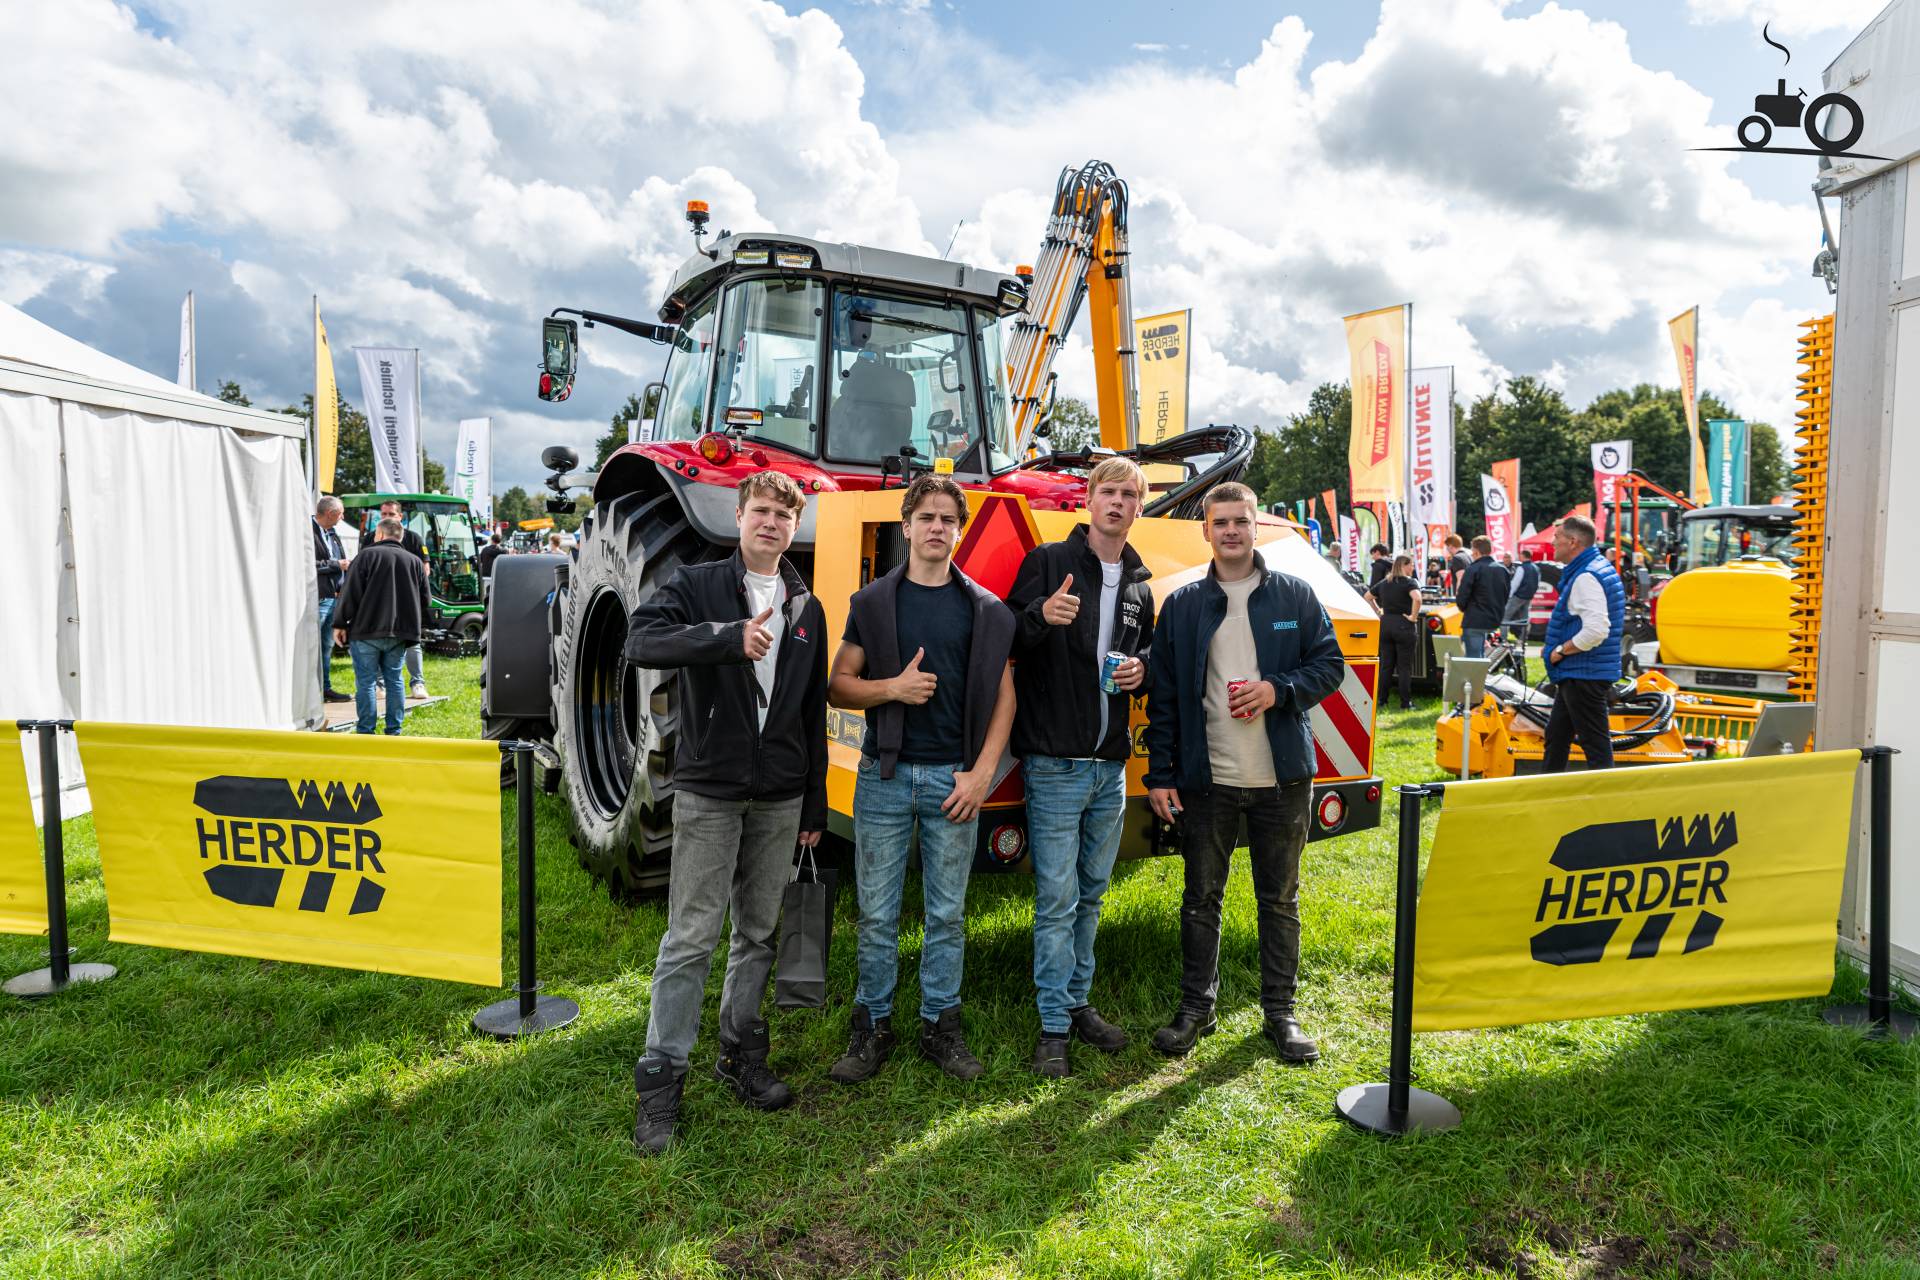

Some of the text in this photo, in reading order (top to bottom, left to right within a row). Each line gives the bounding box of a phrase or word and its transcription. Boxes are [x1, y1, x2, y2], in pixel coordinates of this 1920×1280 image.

[559, 575, 578, 691] TRELLEBORG
[1122, 602, 1141, 614] TROTS
[1123, 615, 1137, 628] BOER
[195, 818, 387, 874] HERDER
[1535, 860, 1730, 923] HERDER
